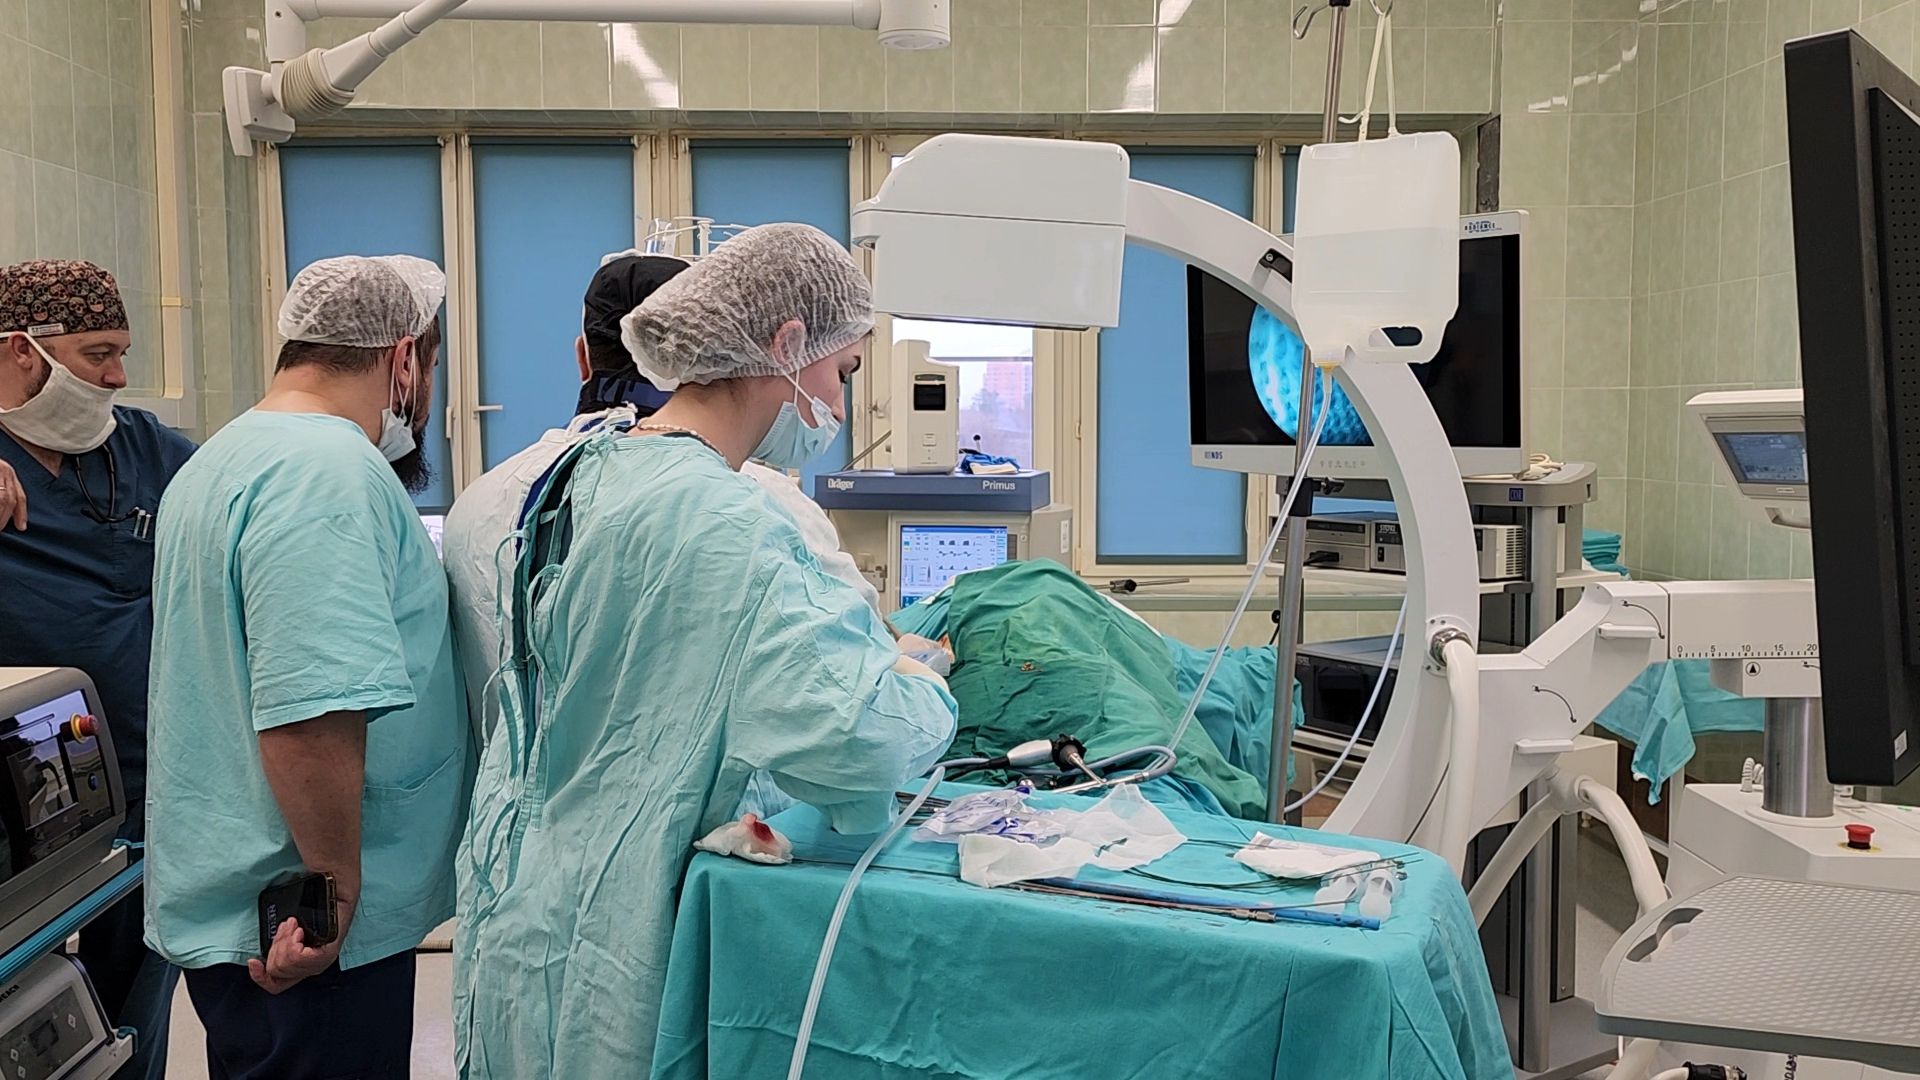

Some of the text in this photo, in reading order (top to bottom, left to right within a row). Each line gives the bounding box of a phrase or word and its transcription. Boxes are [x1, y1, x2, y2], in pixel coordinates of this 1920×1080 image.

[827, 478, 855, 491] Dräger
[982, 480, 1016, 491] Primus
[1677, 643, 1818, 653] 0 5 10 15 20
